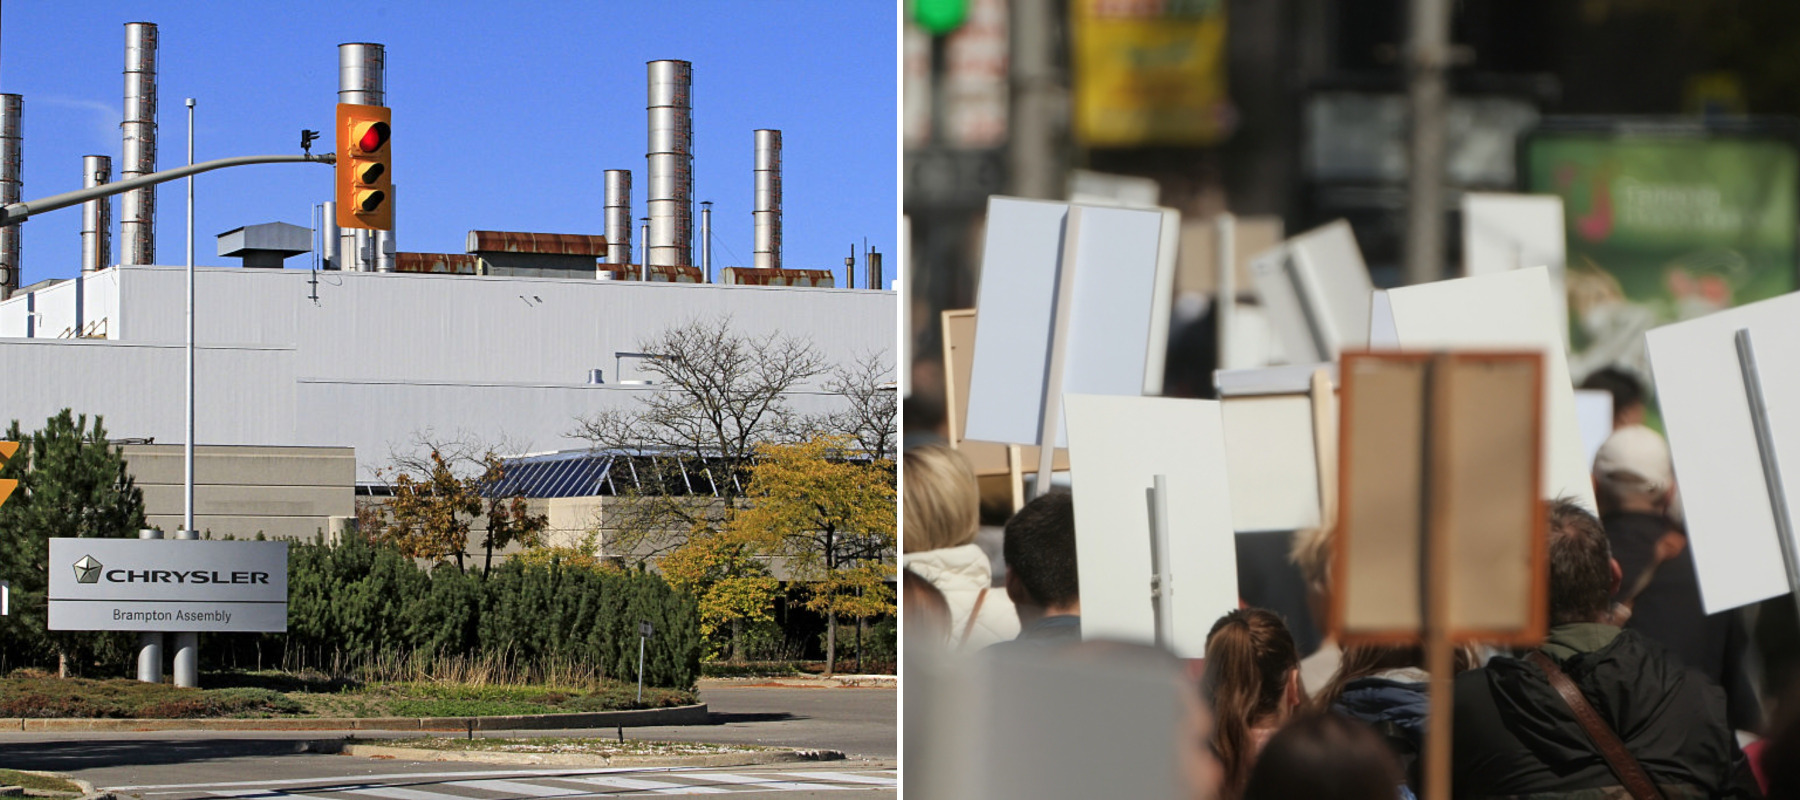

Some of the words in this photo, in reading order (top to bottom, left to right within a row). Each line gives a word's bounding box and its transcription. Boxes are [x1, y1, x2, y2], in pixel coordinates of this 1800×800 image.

[106, 570, 269, 584] CHRYSLER
[113, 609, 172, 623] Brampton
[176, 609, 231, 624] Assembly
